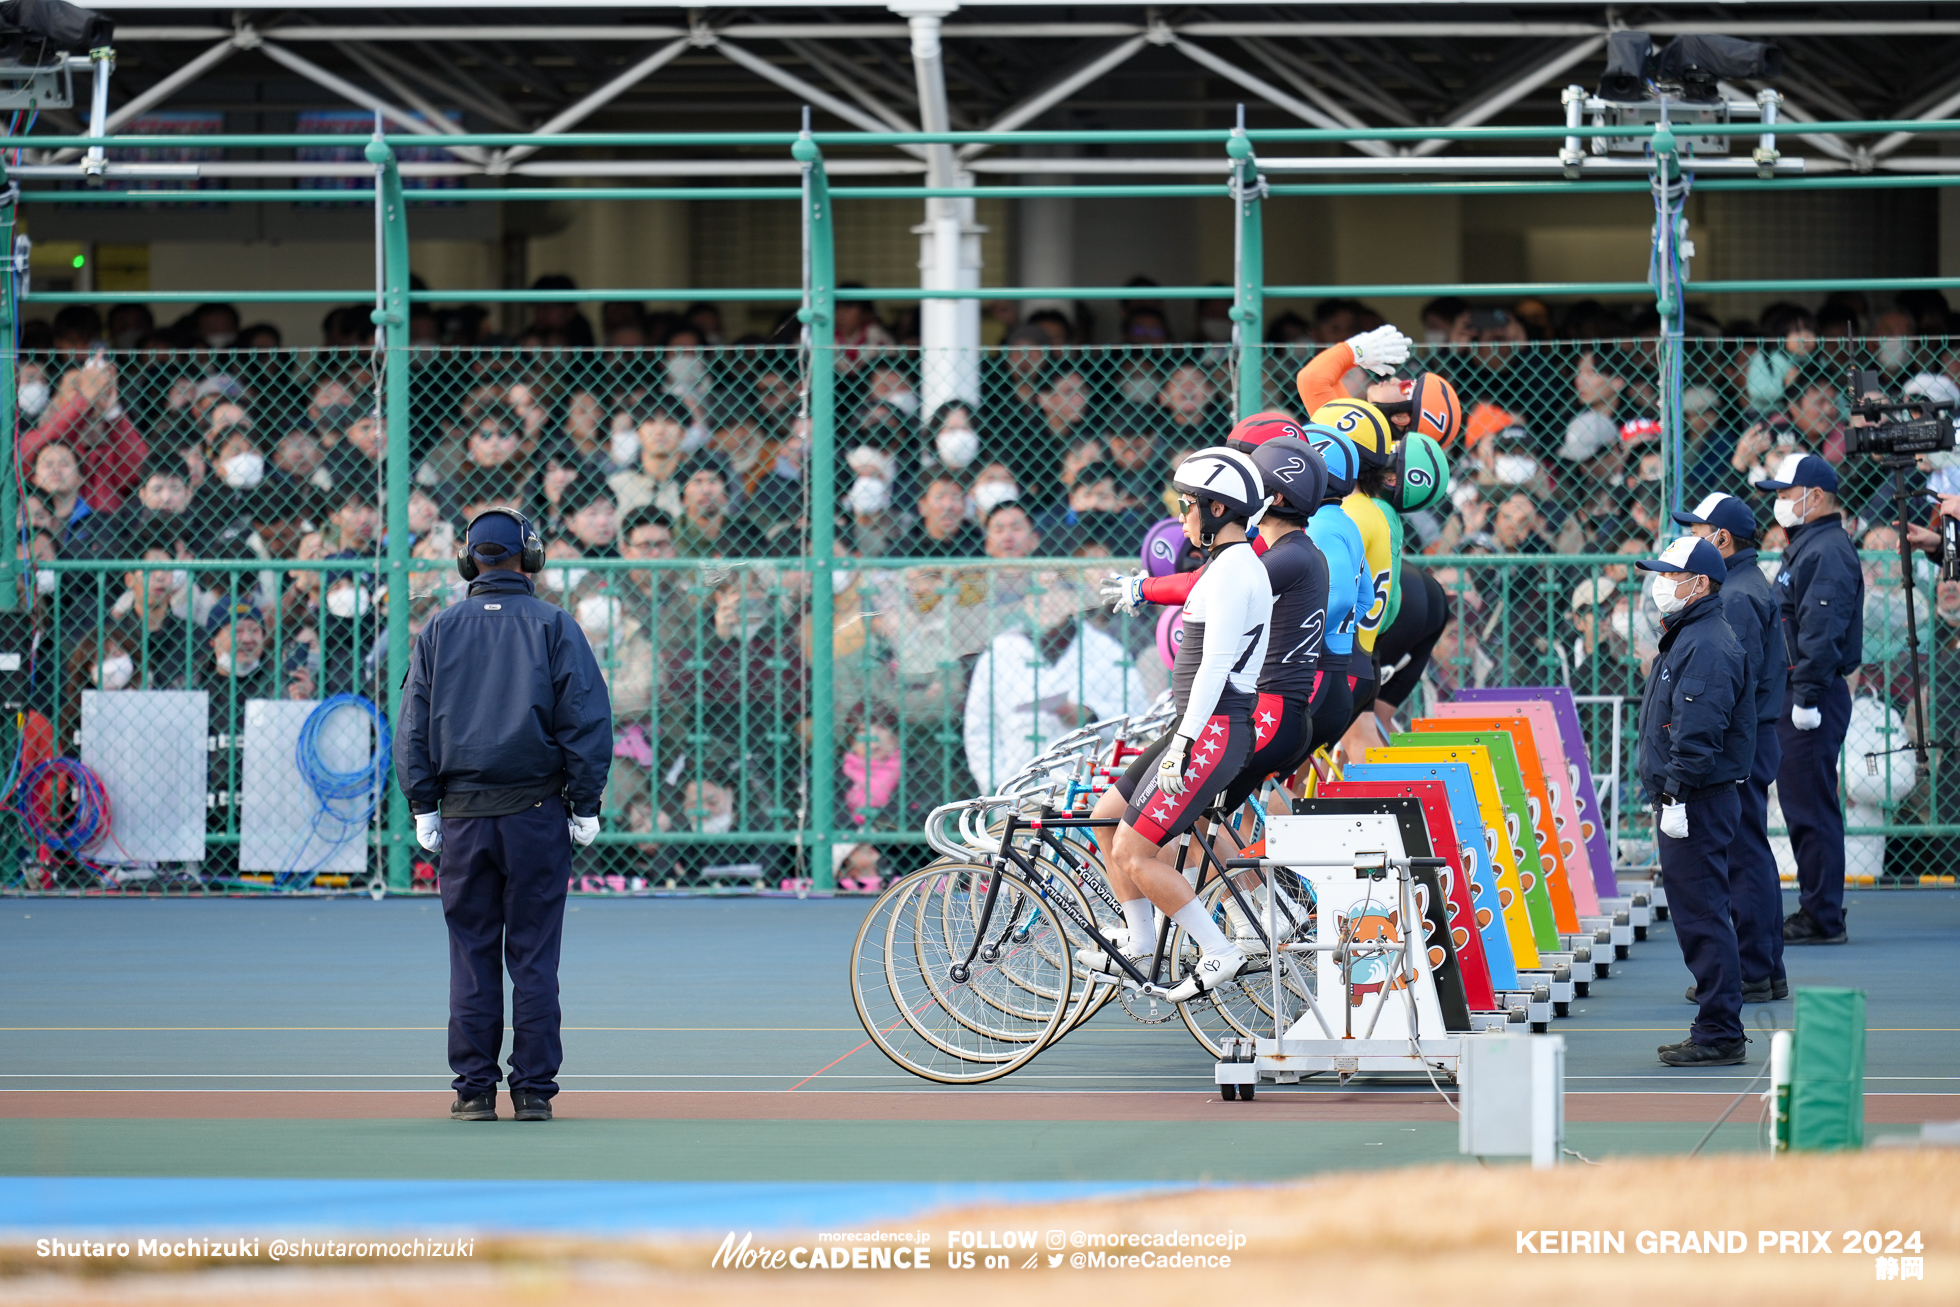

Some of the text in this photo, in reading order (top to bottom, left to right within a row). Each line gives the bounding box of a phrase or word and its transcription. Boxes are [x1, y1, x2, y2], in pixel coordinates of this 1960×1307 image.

[1335, 409, 1366, 433] 5
[1421, 408, 1447, 433] 7
[1311, 438, 1335, 459] 4
[1203, 463, 1227, 487] 1
[1273, 457, 1306, 484] 2
[1406, 467, 1433, 489] 6
[1151, 536, 1176, 565] 9
[1356, 568, 1391, 632] 5
[1230, 623, 1264, 674] 1
[1281, 608, 1326, 664] 2
